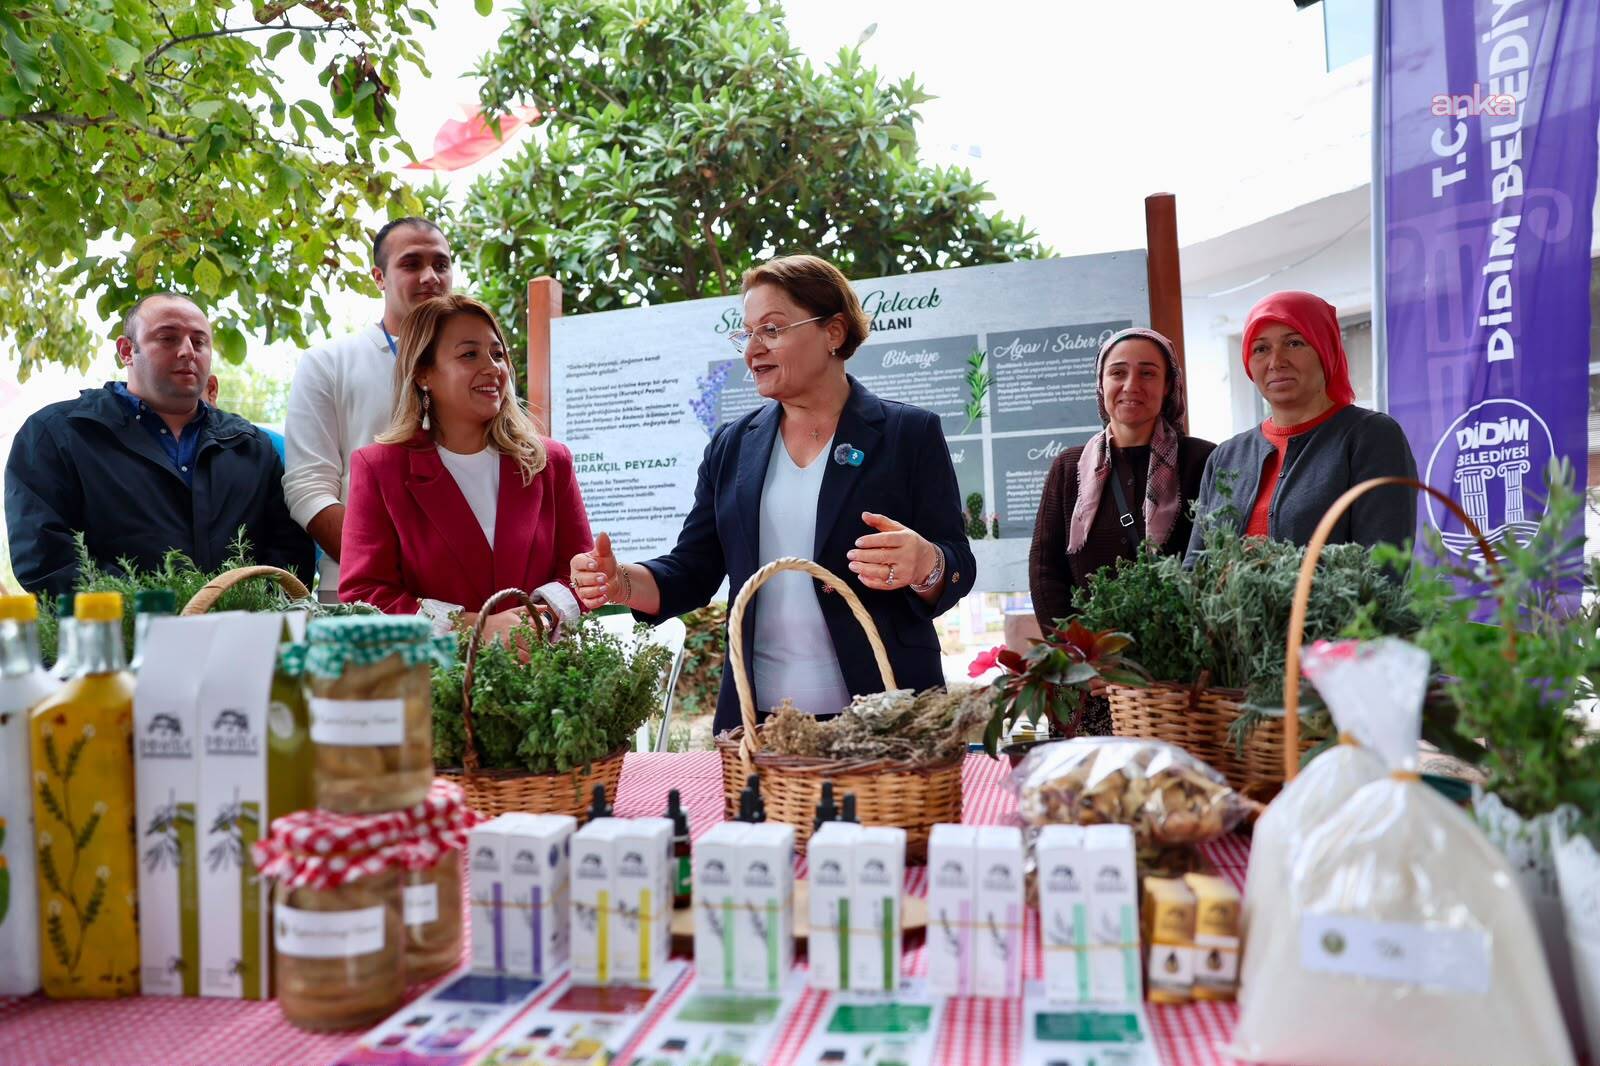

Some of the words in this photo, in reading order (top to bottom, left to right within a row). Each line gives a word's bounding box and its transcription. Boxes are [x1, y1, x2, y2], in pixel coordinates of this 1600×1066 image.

[1431, 107, 1468, 198] T.C.
[1479, 215, 1521, 362] DİDİM
[861, 288, 943, 321] Gelecek
[881, 349, 941, 369] Biberiye
[992, 337, 1041, 361] Agav
[1456, 416, 1530, 450] DİDİM
[625, 458, 677, 470] PEYZAJ?
[1456, 443, 1529, 467] BELEDİYESİ
